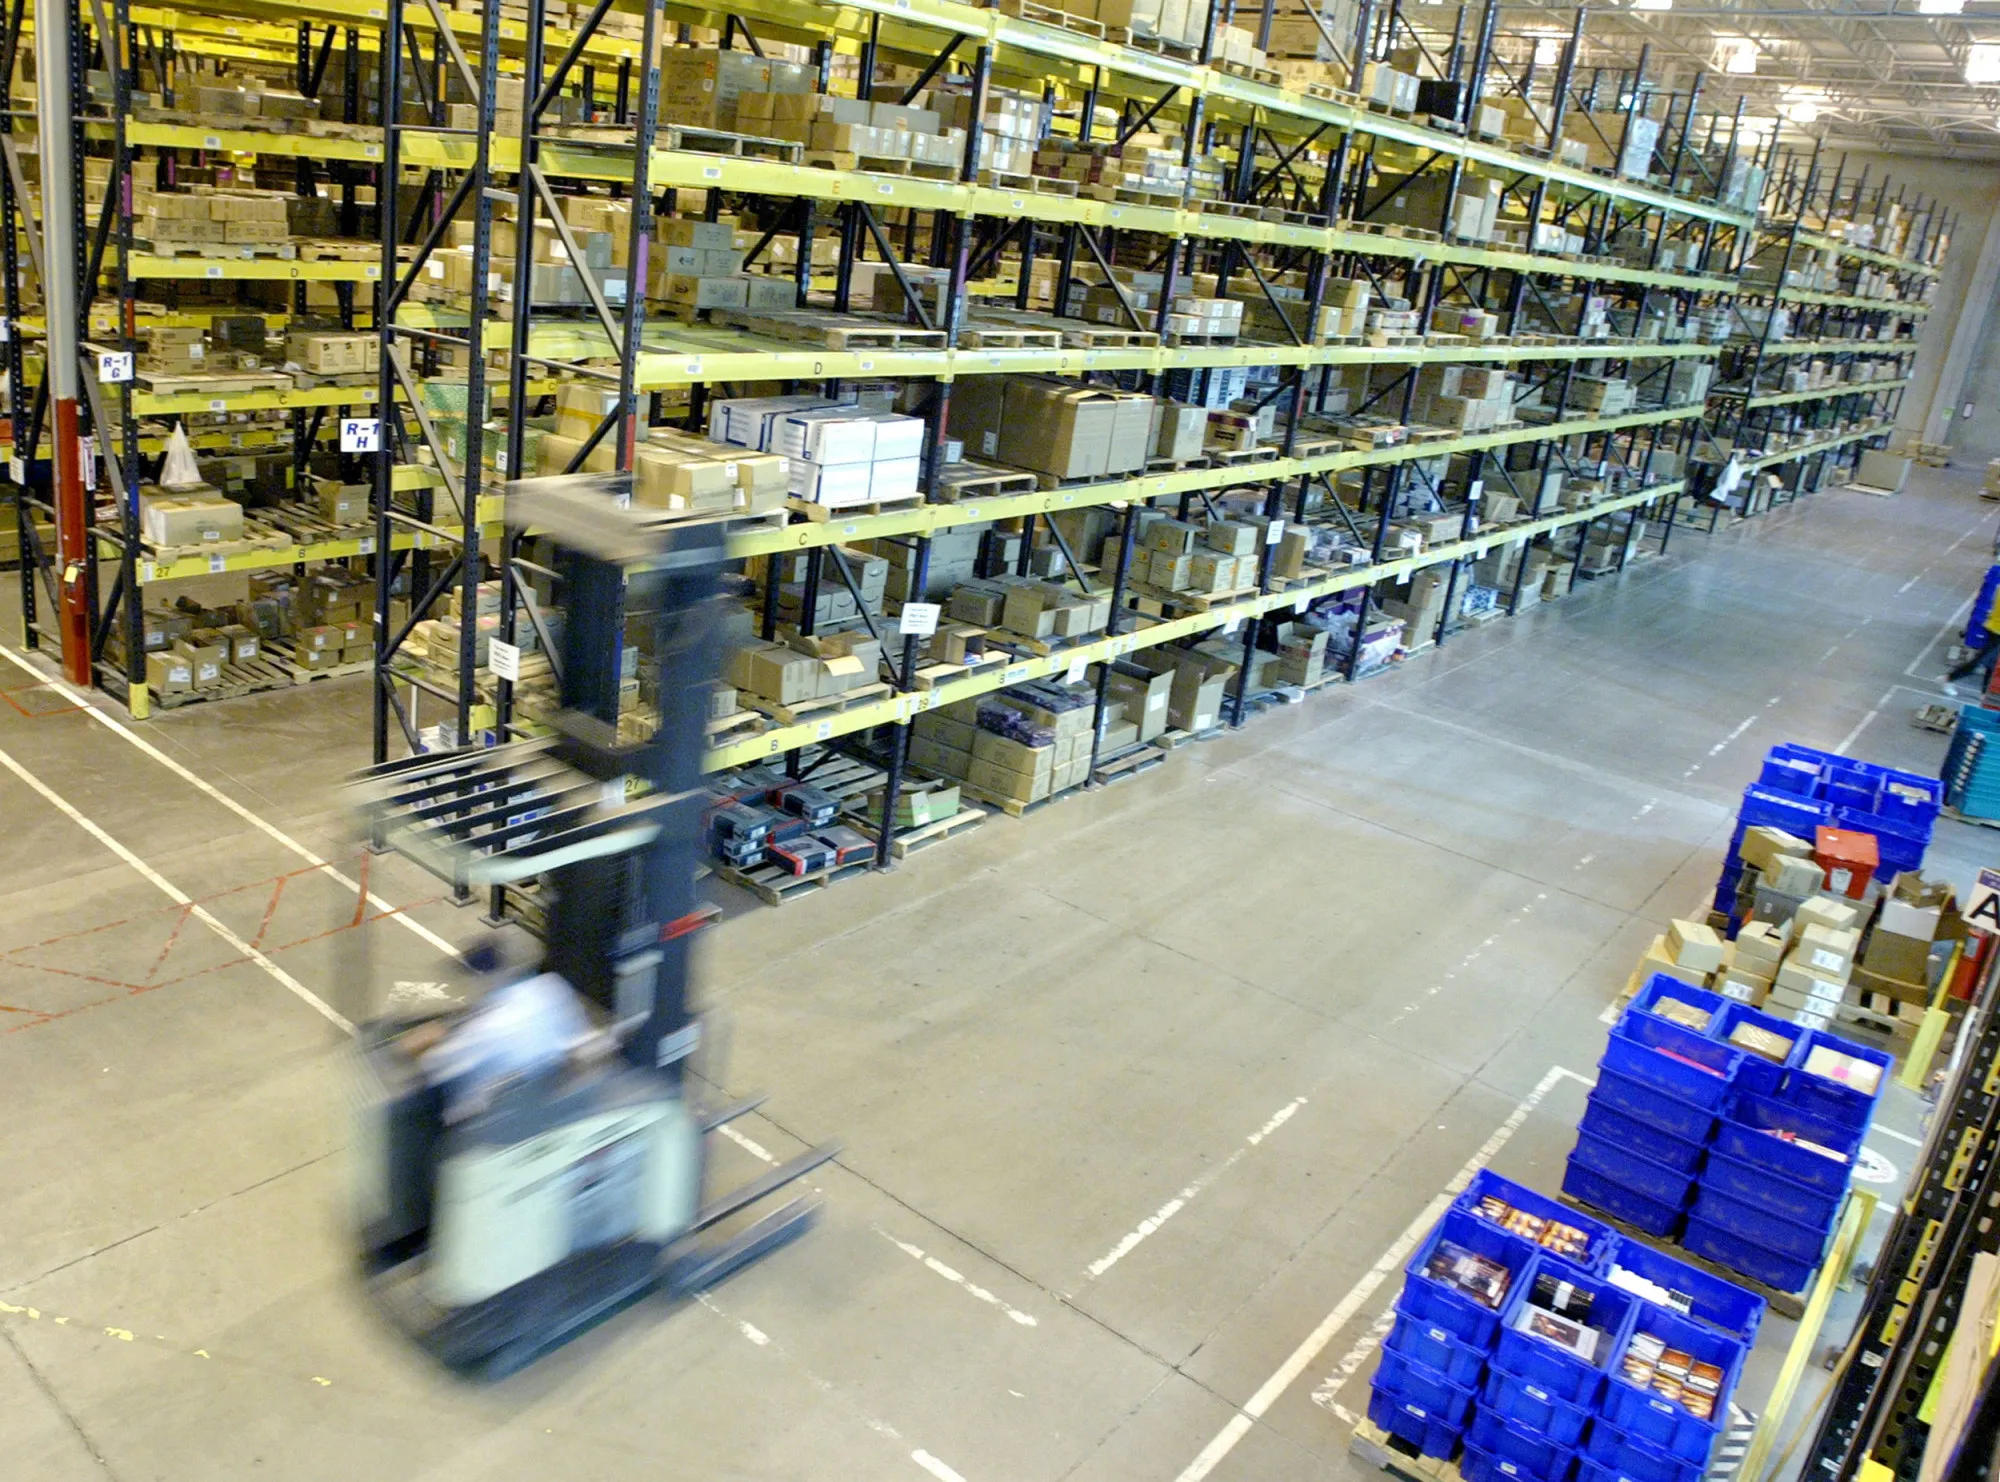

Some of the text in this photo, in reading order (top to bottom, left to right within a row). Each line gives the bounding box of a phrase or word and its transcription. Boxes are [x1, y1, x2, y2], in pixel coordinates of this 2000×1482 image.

[831, 180, 842, 195] E
[290, 267, 299, 278] D
[103, 355, 128, 368] R-1
[1061, 357, 1069, 369] D
[814, 361, 824, 376] D
[548, 381, 557, 391] C
[278, 394, 288, 405] C
[346, 422, 379, 436] R-1
[356, 436, 369, 449] H
[1043, 498, 1052, 510] C
[799, 532, 809, 546] C
[156, 567, 170, 579] 27
[771, 739, 780, 752] B
[625, 776, 640, 793] 27
[1968, 892, 2000, 930] A
